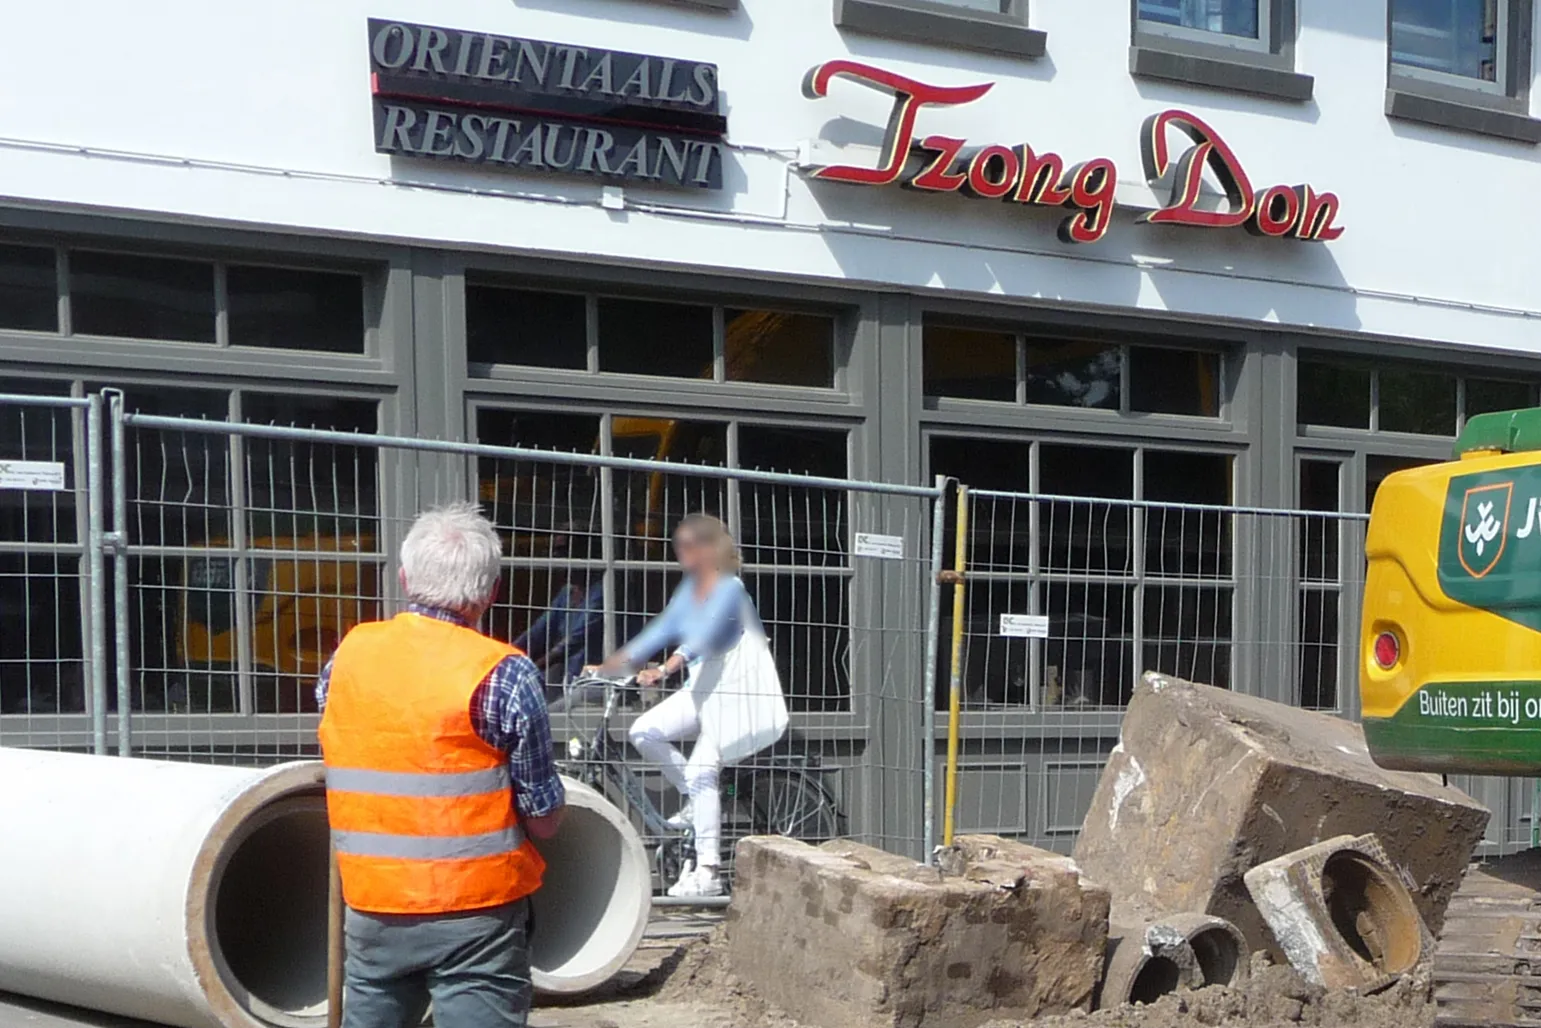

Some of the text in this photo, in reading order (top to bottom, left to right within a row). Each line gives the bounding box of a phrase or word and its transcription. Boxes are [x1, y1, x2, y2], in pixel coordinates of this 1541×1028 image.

[372, 22, 719, 107] ORIENTAALS
[380, 105, 723, 186] RESTAURANT
[803, 59, 1346, 244] Tzong Don
[1419, 689, 1468, 717] Buiten
[1472, 690, 1493, 718] zit
[1497, 691, 1520, 725] bij
